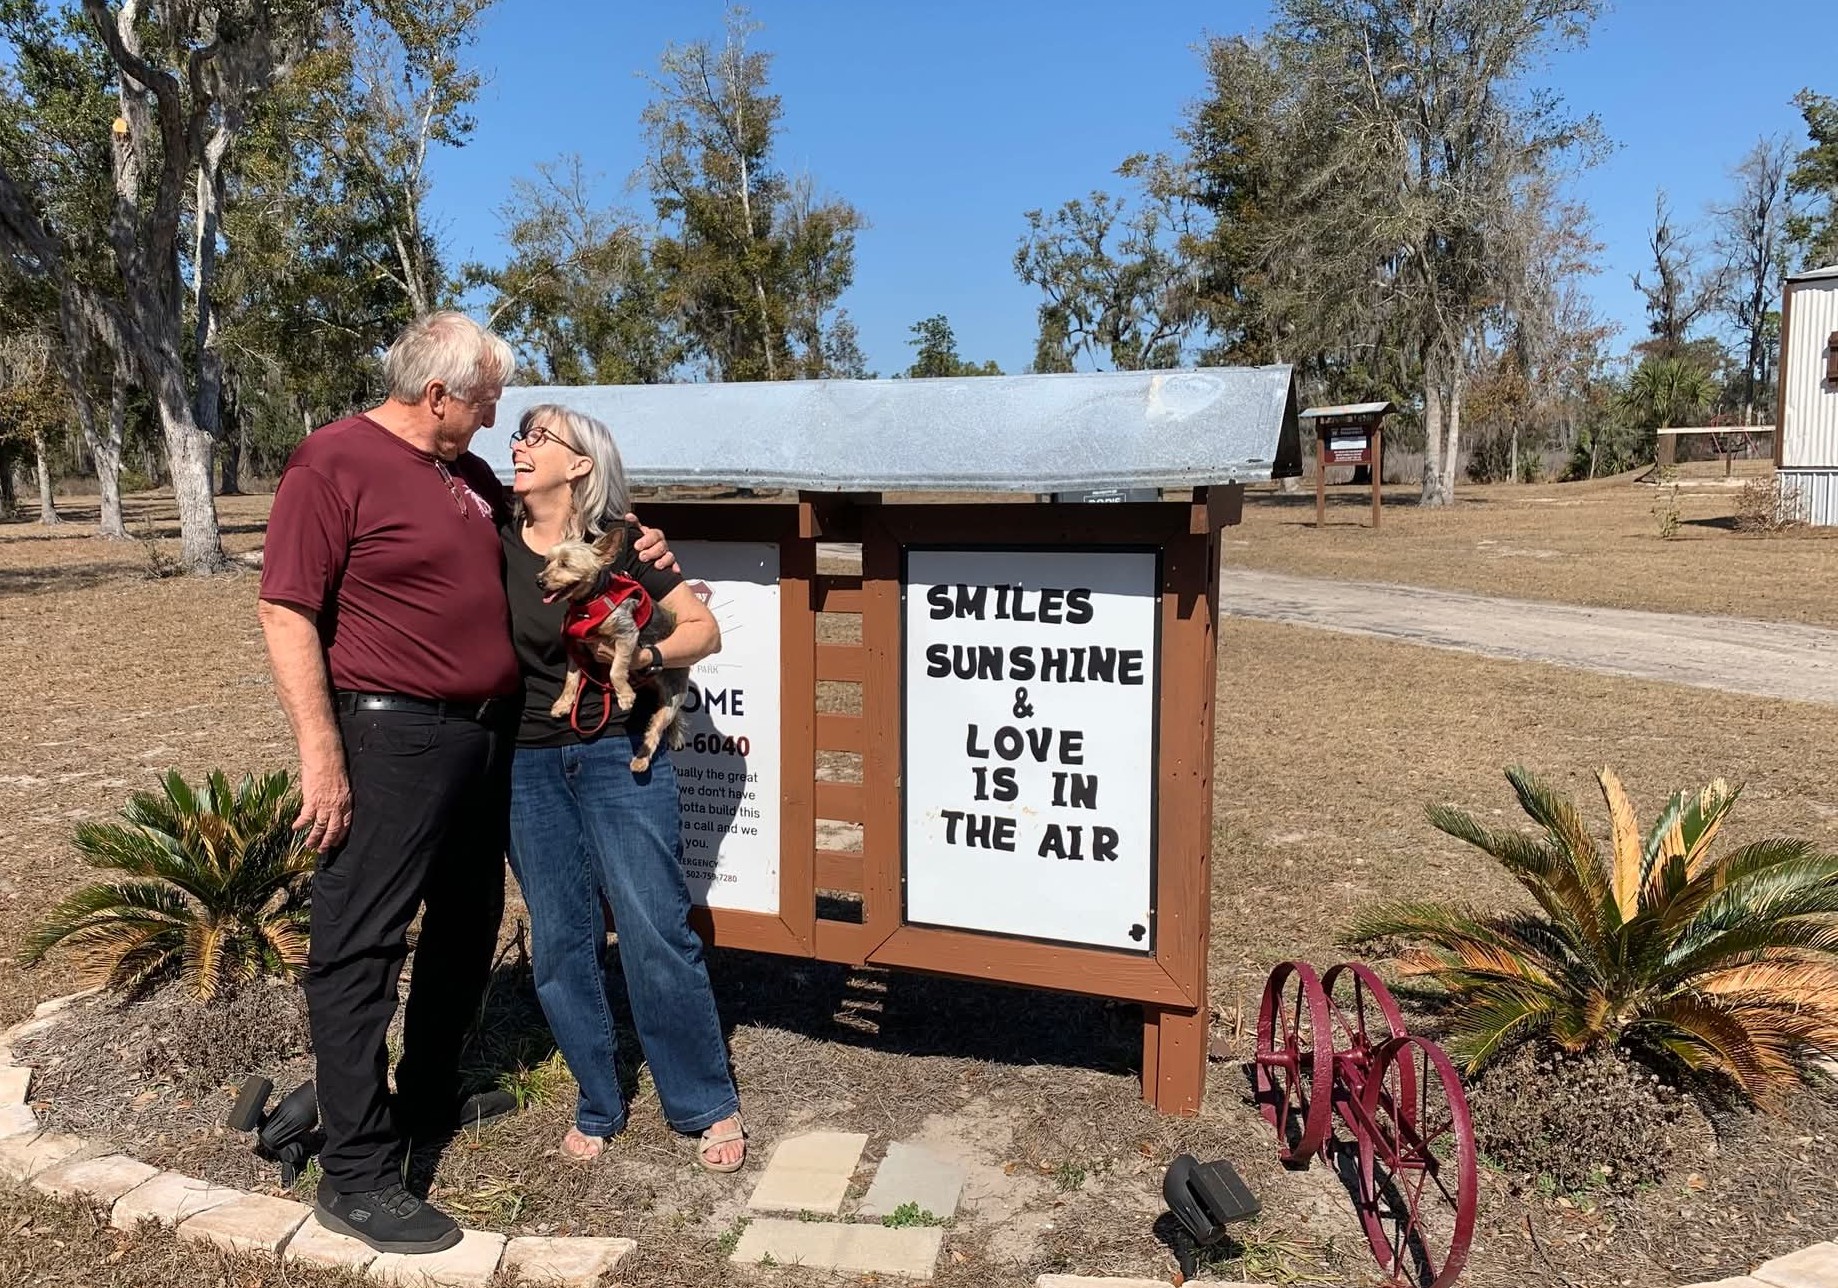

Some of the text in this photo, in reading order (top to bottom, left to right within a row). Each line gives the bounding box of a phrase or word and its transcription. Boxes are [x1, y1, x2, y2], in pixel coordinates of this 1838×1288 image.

[926, 583, 1093, 625] SMILES
[926, 644, 1144, 685] SUNSHINE
[1013, 687, 1034, 719] &
[667, 733, 750, 757] -6040
[966, 724, 1083, 765] LOVE
[672, 766, 758, 783] ually the great
[679, 786, 756, 800] we don't have
[972, 767, 1098, 810] IS IN
[709, 803, 736, 816] build
[740, 807, 760, 818] this
[684, 821, 758, 836] a call and we
[940, 810, 1119, 862] THE AIR
[685, 838, 709, 849] you.
[680, 858, 718, 868] ERGENCY
